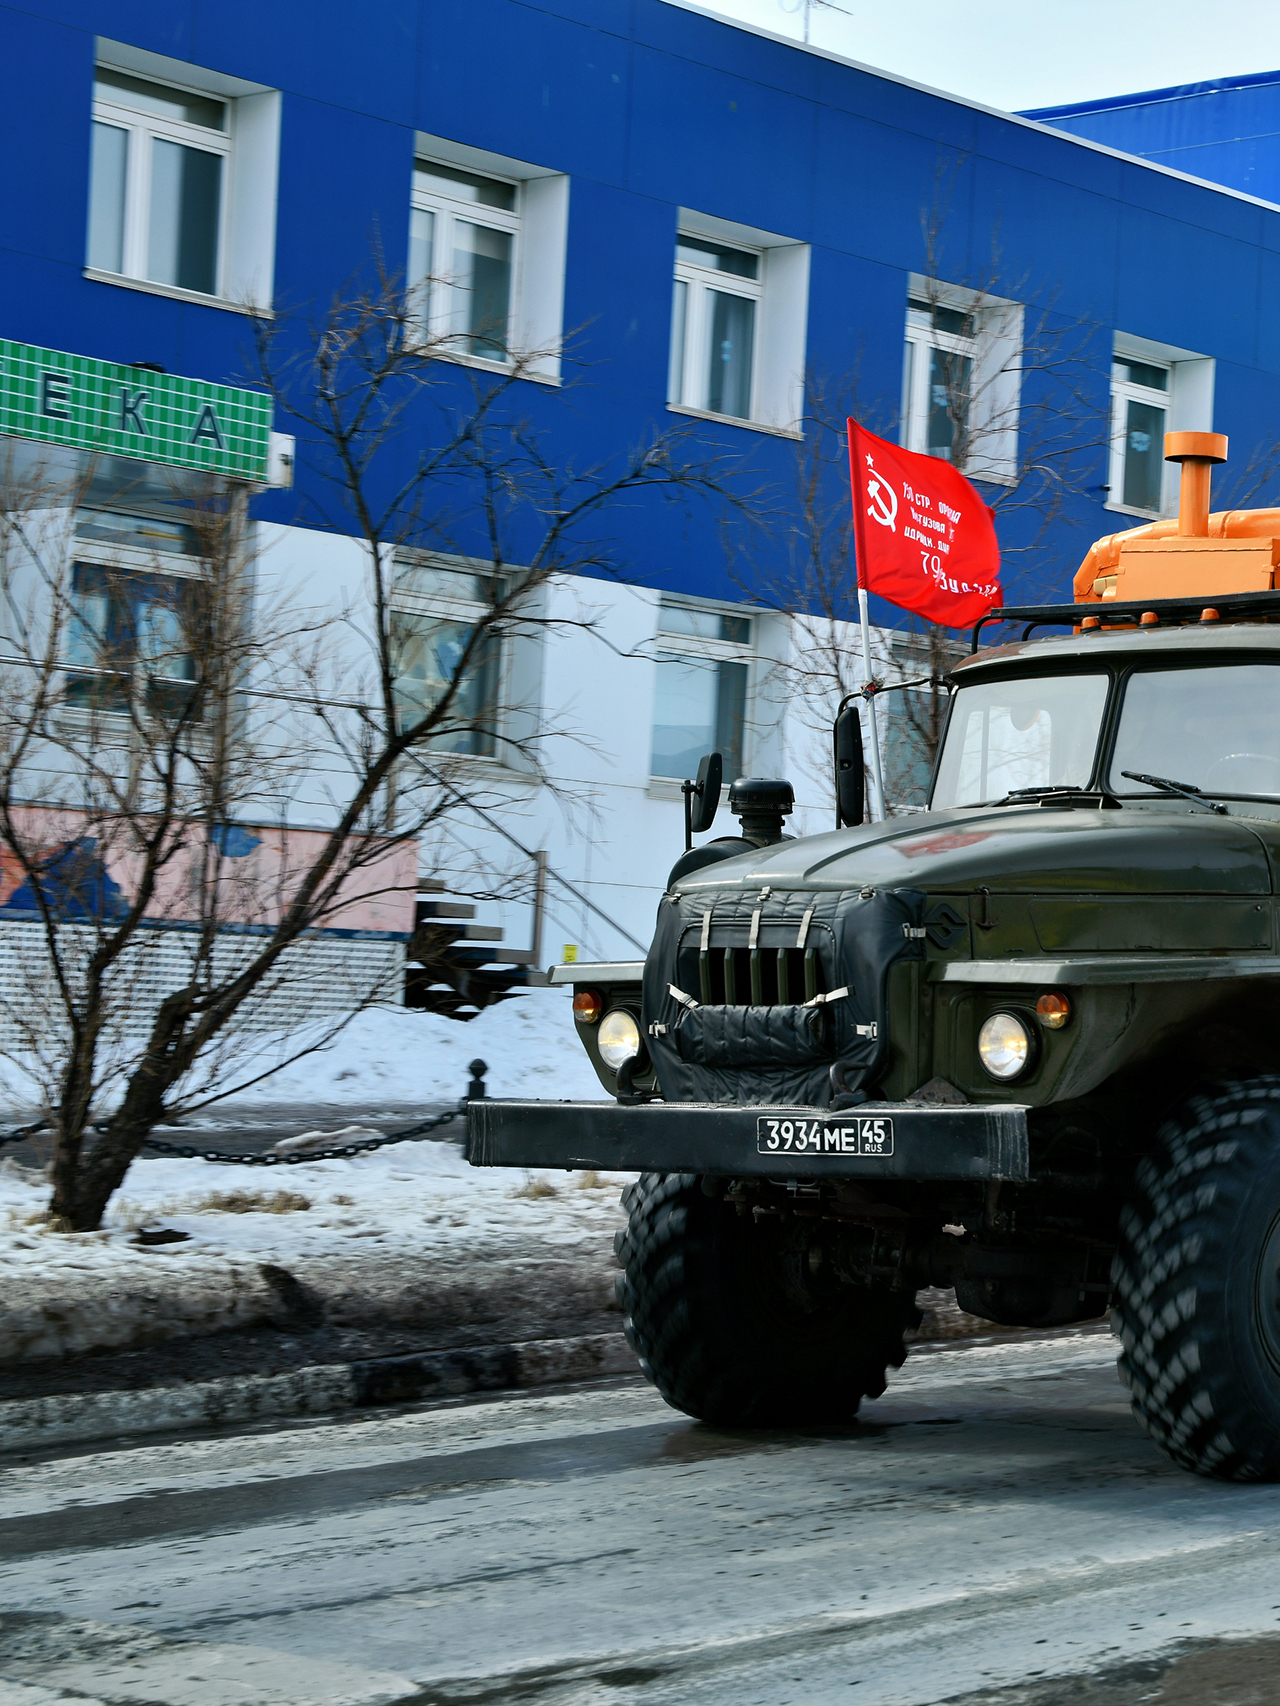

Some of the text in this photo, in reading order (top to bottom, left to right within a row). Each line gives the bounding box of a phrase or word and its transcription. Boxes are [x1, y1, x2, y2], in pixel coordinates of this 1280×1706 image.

[0, 362, 227, 450] ЕКА
[915, 493, 933, 510] СТР.
[920, 550, 941, 579] 79
[861, 1120, 886, 1144] 45
[864, 1143, 883, 1153] RUS
